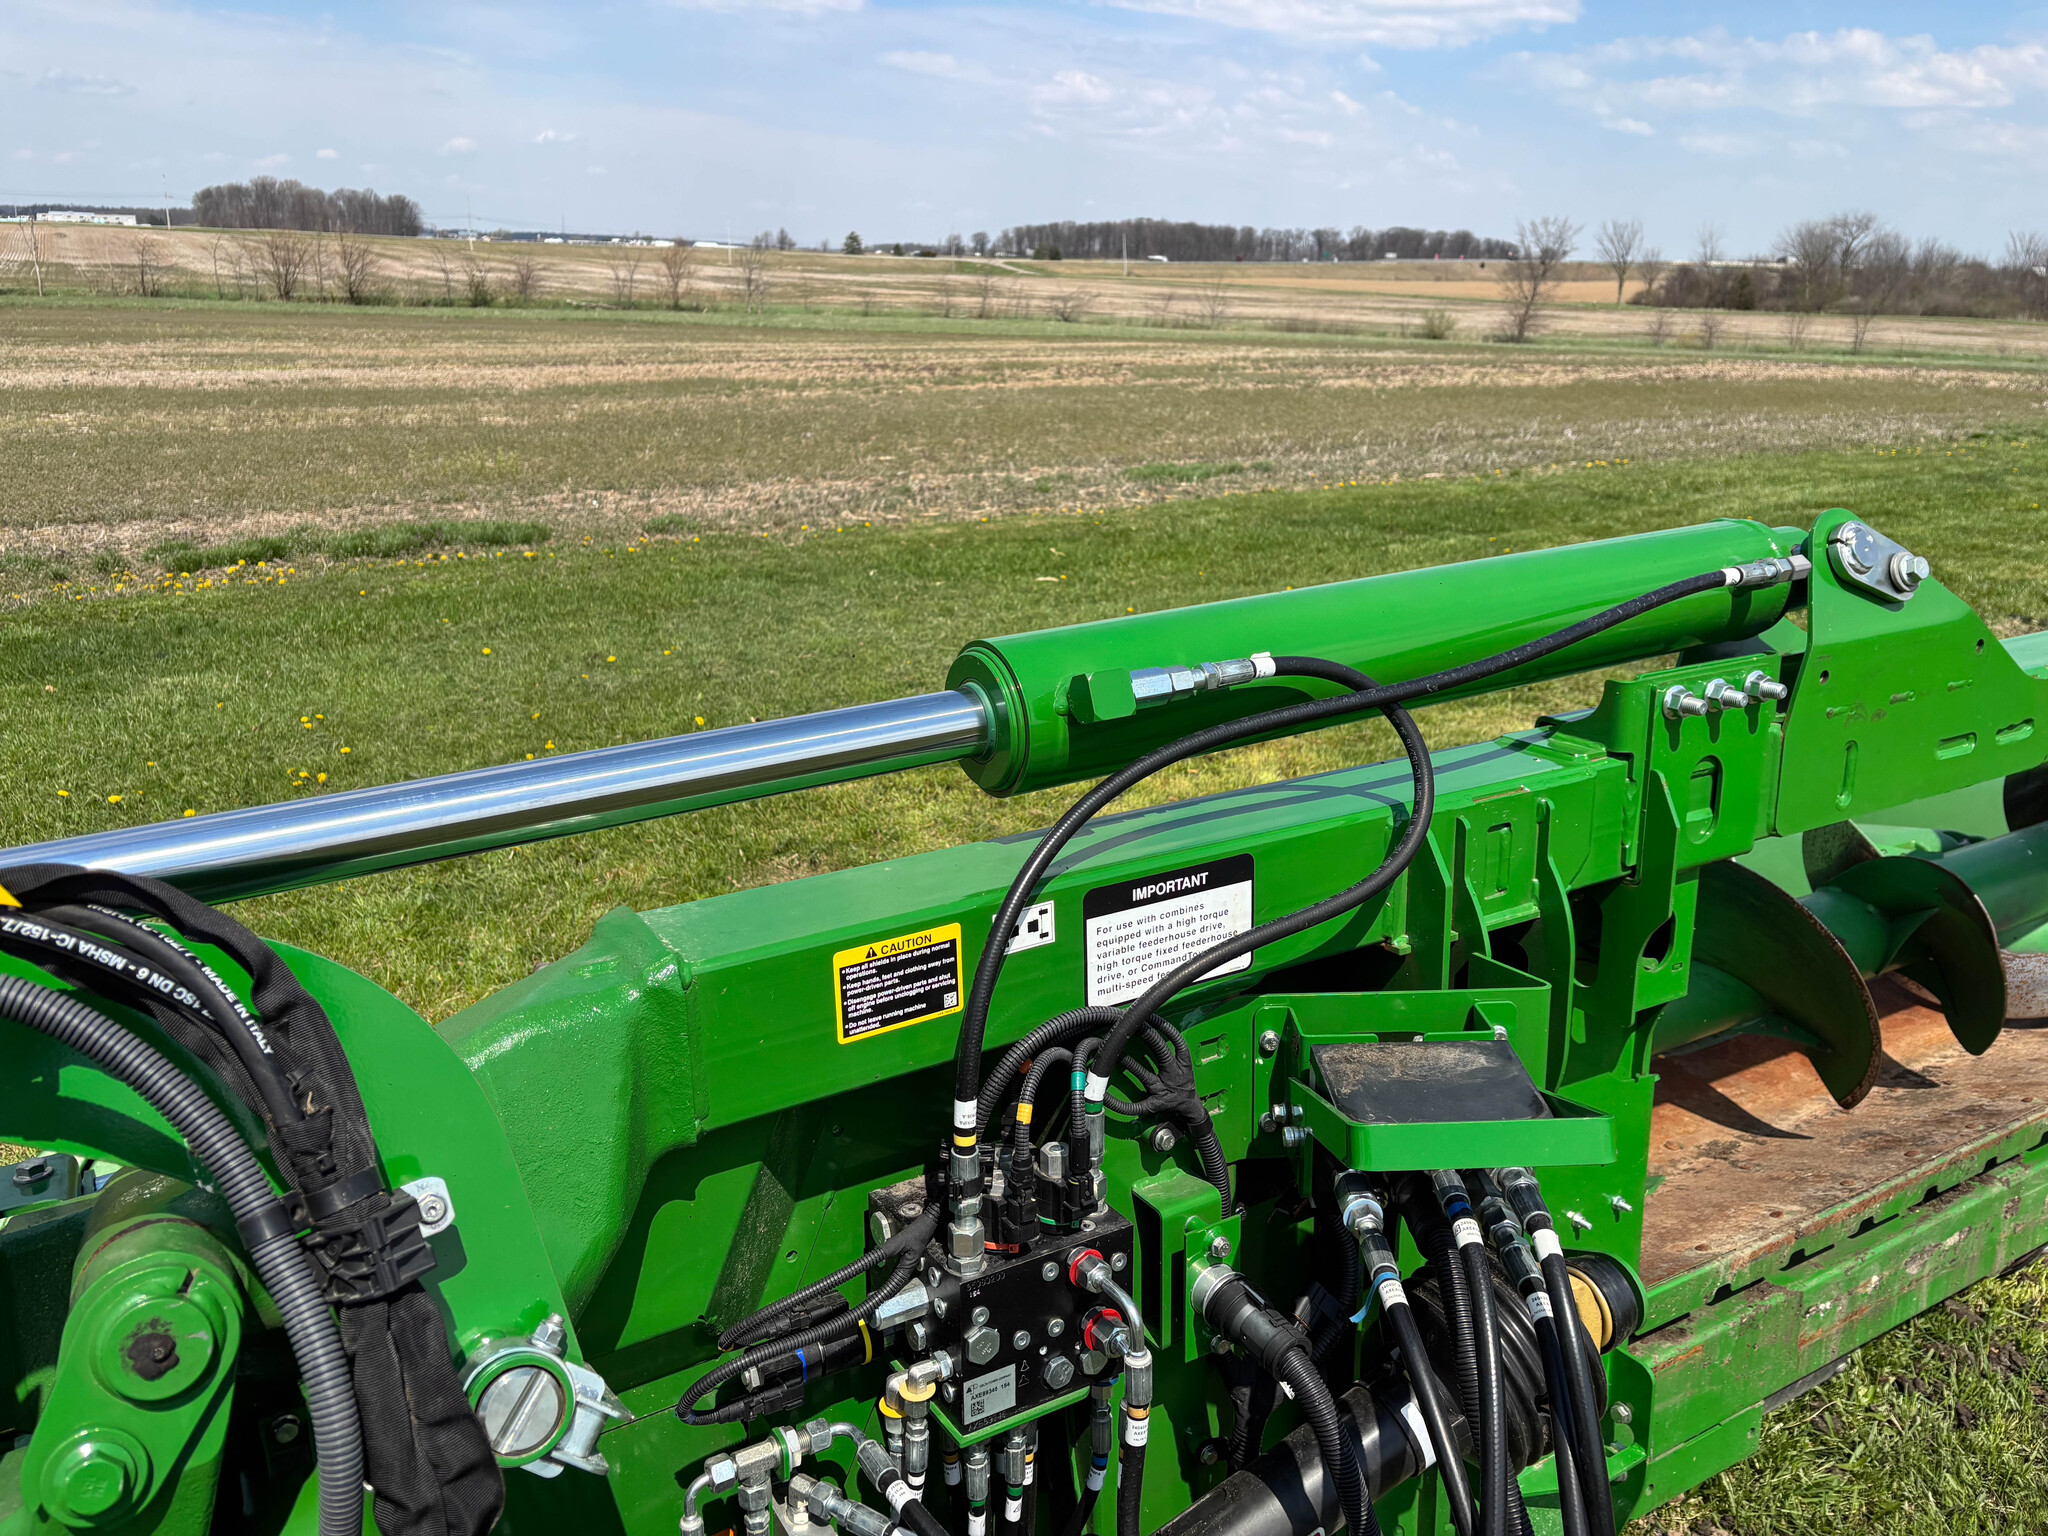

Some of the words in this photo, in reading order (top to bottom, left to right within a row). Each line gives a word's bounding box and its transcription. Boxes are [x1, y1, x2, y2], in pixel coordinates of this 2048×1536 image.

[1132, 872, 1208, 901] IMPORTANT
[1096, 926, 1112, 935] For
[1117, 921, 1133, 931] use
[1137, 915, 1156, 926] with
[1160, 902, 1204, 920] combines
[1096, 931, 1141, 948] equipped
[1145, 922, 1164, 935] with
[1177, 917, 1196, 931] high
[1200, 909, 1229, 922] torque
[881, 934, 932, 955] CAUTION
[1097, 944, 1135, 960] variable
[1139, 929, 1196, 949] feederhouse
[1200, 922, 1225, 933] drive,
[1097, 962, 1118, 973] high
[1122, 952, 1152, 966] torque
[1156, 944, 1179, 957] fixed
[1182, 929, 1238, 950] feederhouse
[78, 940, 128, 970] MSHA
[870, 958, 889, 968] shields
[897, 953, 912, 962] place
[913, 948, 930, 957] during
[932, 942, 950, 952] normal
[136, 967, 150, 980] 6
[846, 969, 877, 981] operations.
[905, 963, 926, 974] clothing
[928, 960, 941, 968] away
[148, 972, 175, 993] DN
[1097, 973, 1124, 984] drive,
[1097, 975, 1154, 997] multi-speed
[173, 987, 200, 1008] 1SC
[847, 983, 883, 997] power-driven
[848, 994, 876, 1005] Disengage
[878, 984, 912, 998] power-driven
[913, 980, 927, 988] parts
[857, 1001, 875, 1010] engine
[876, 996, 893, 1004] before
[895, 988, 924, 1000] unclogging
[932, 979, 955, 989] servicing
[202, 966, 239, 1003] MADE
[234, 1003, 250, 1019] IN
[245, 1019, 274, 1054] ITALY
[883, 1009, 903, 1019] running
[904, 1003, 926, 1013] machine
[849, 1023, 880, 1035] unattended.
